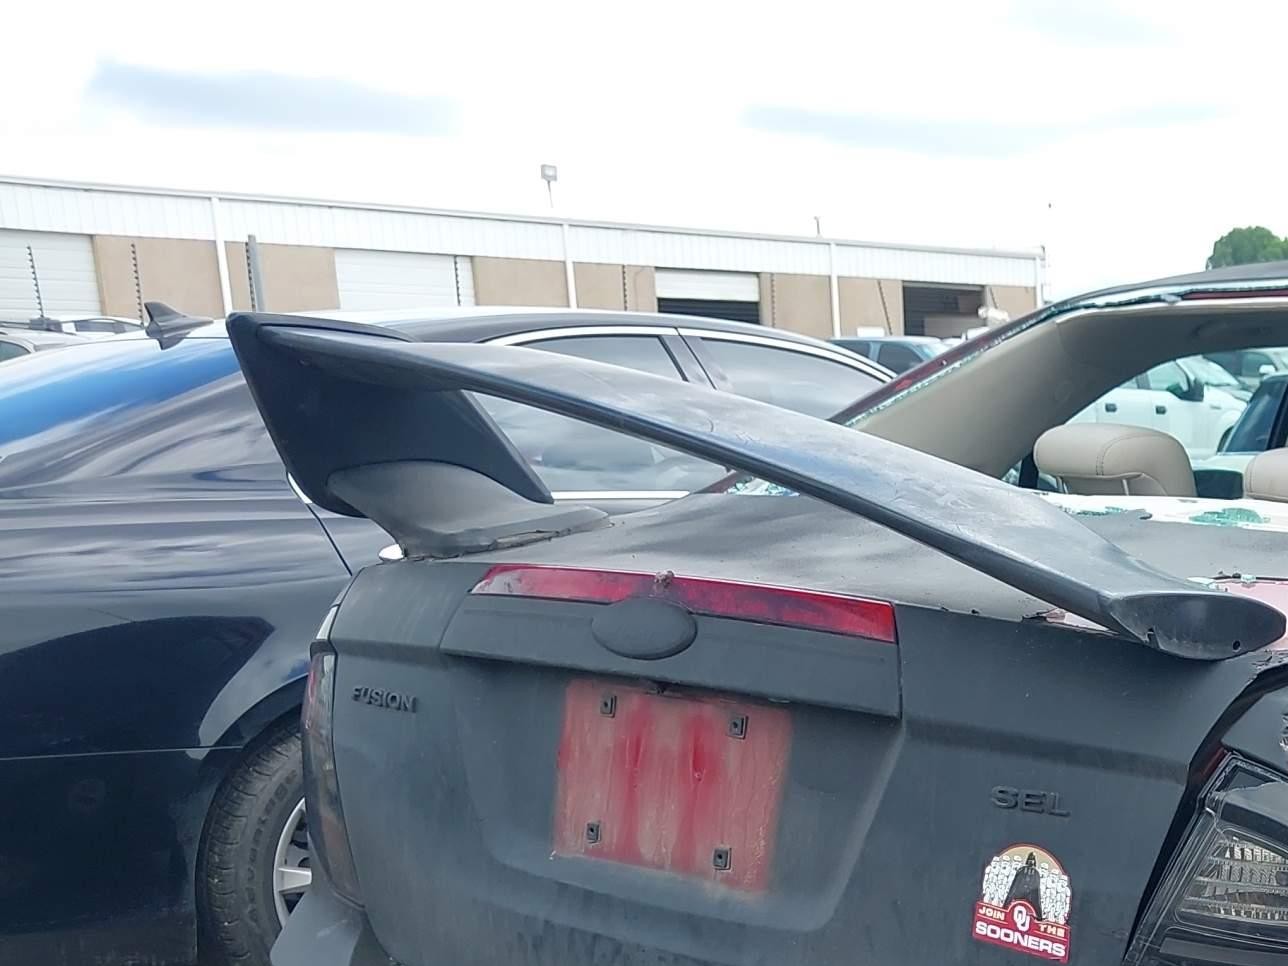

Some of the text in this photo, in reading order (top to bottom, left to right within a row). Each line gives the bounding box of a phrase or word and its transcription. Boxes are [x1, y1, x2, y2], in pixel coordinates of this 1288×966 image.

[351, 686, 418, 713] FUSION
[990, 785, 1071, 817] SEL
[975, 920, 1066, 956] SOONERS
[978, 907, 1065, 938] JOIN THE
